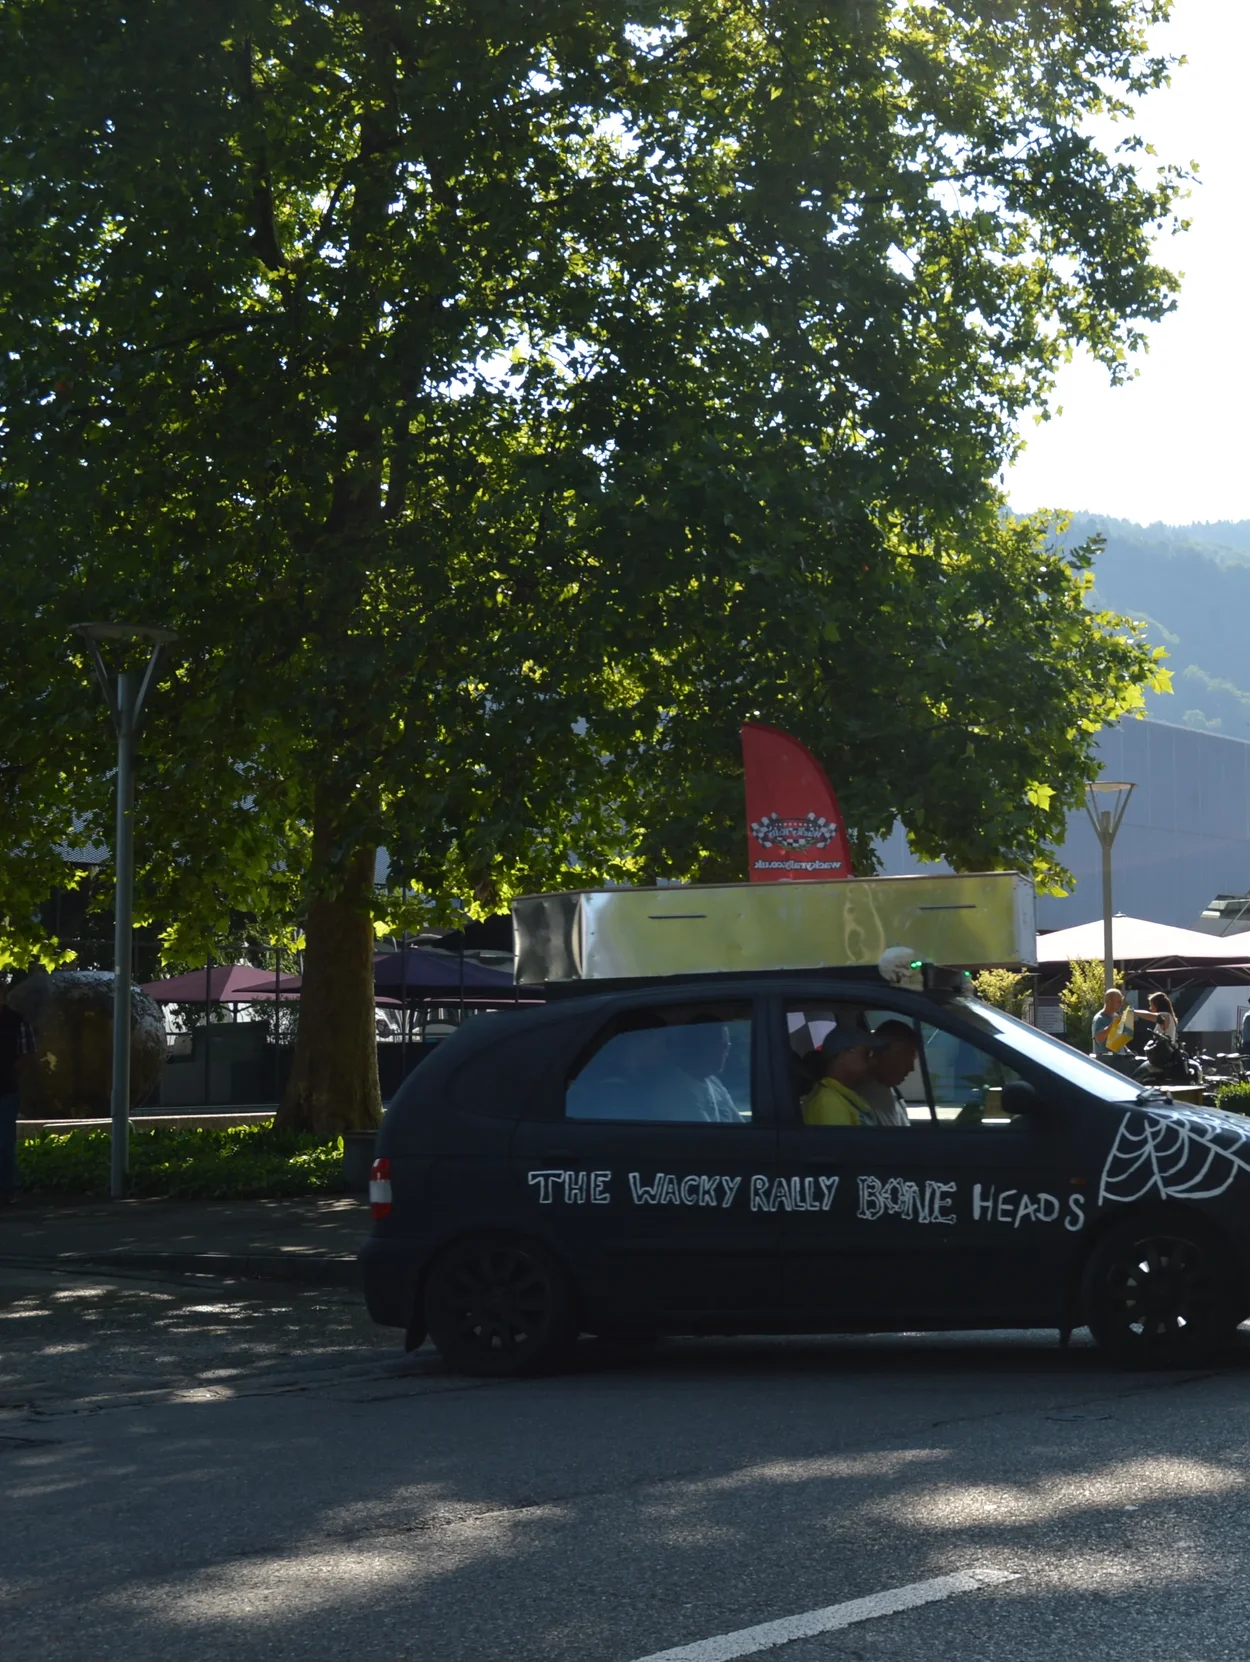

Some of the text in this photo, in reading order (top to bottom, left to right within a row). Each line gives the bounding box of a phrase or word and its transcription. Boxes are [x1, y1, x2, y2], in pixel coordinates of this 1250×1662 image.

[528, 1170, 1085, 1231] THE WACKY RALLY BONE HEADS
